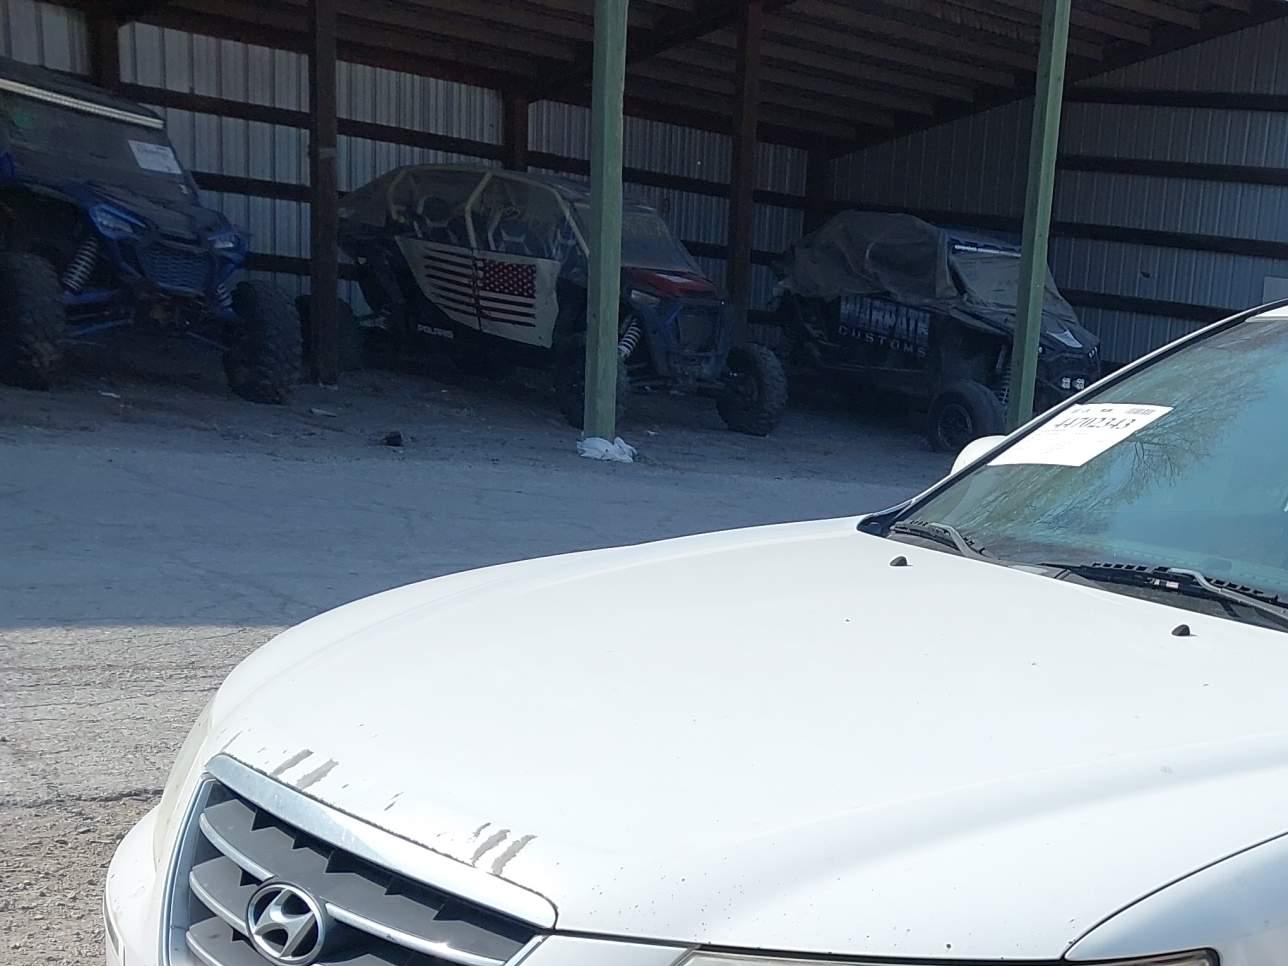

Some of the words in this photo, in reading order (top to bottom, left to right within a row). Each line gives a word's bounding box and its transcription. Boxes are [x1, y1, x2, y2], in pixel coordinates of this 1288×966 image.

[416, 323, 454, 340] POLARIS
[838, 324, 928, 359] CUSTOMS
[1054, 416, 1137, 430] 44702343
